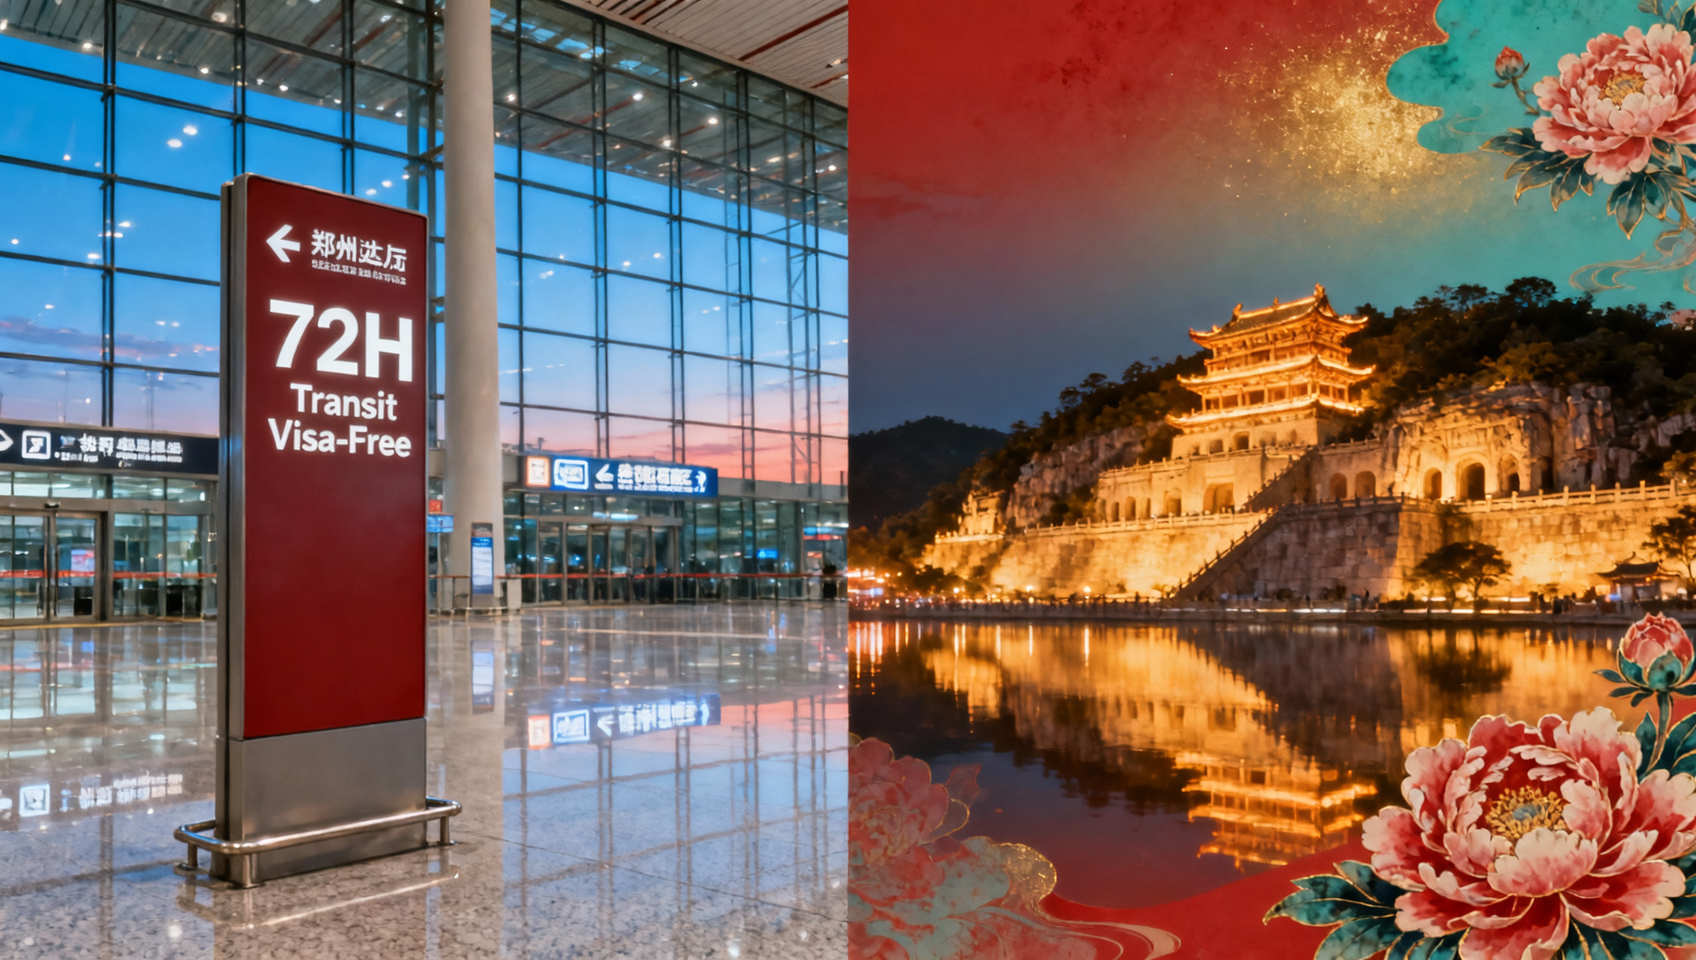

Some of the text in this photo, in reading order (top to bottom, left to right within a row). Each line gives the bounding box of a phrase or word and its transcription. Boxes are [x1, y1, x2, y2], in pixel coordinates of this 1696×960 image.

[269, 298, 414, 382] 72H
[289, 382, 398, 421] Transit
[267, 418, 412, 457] Visa-Free
